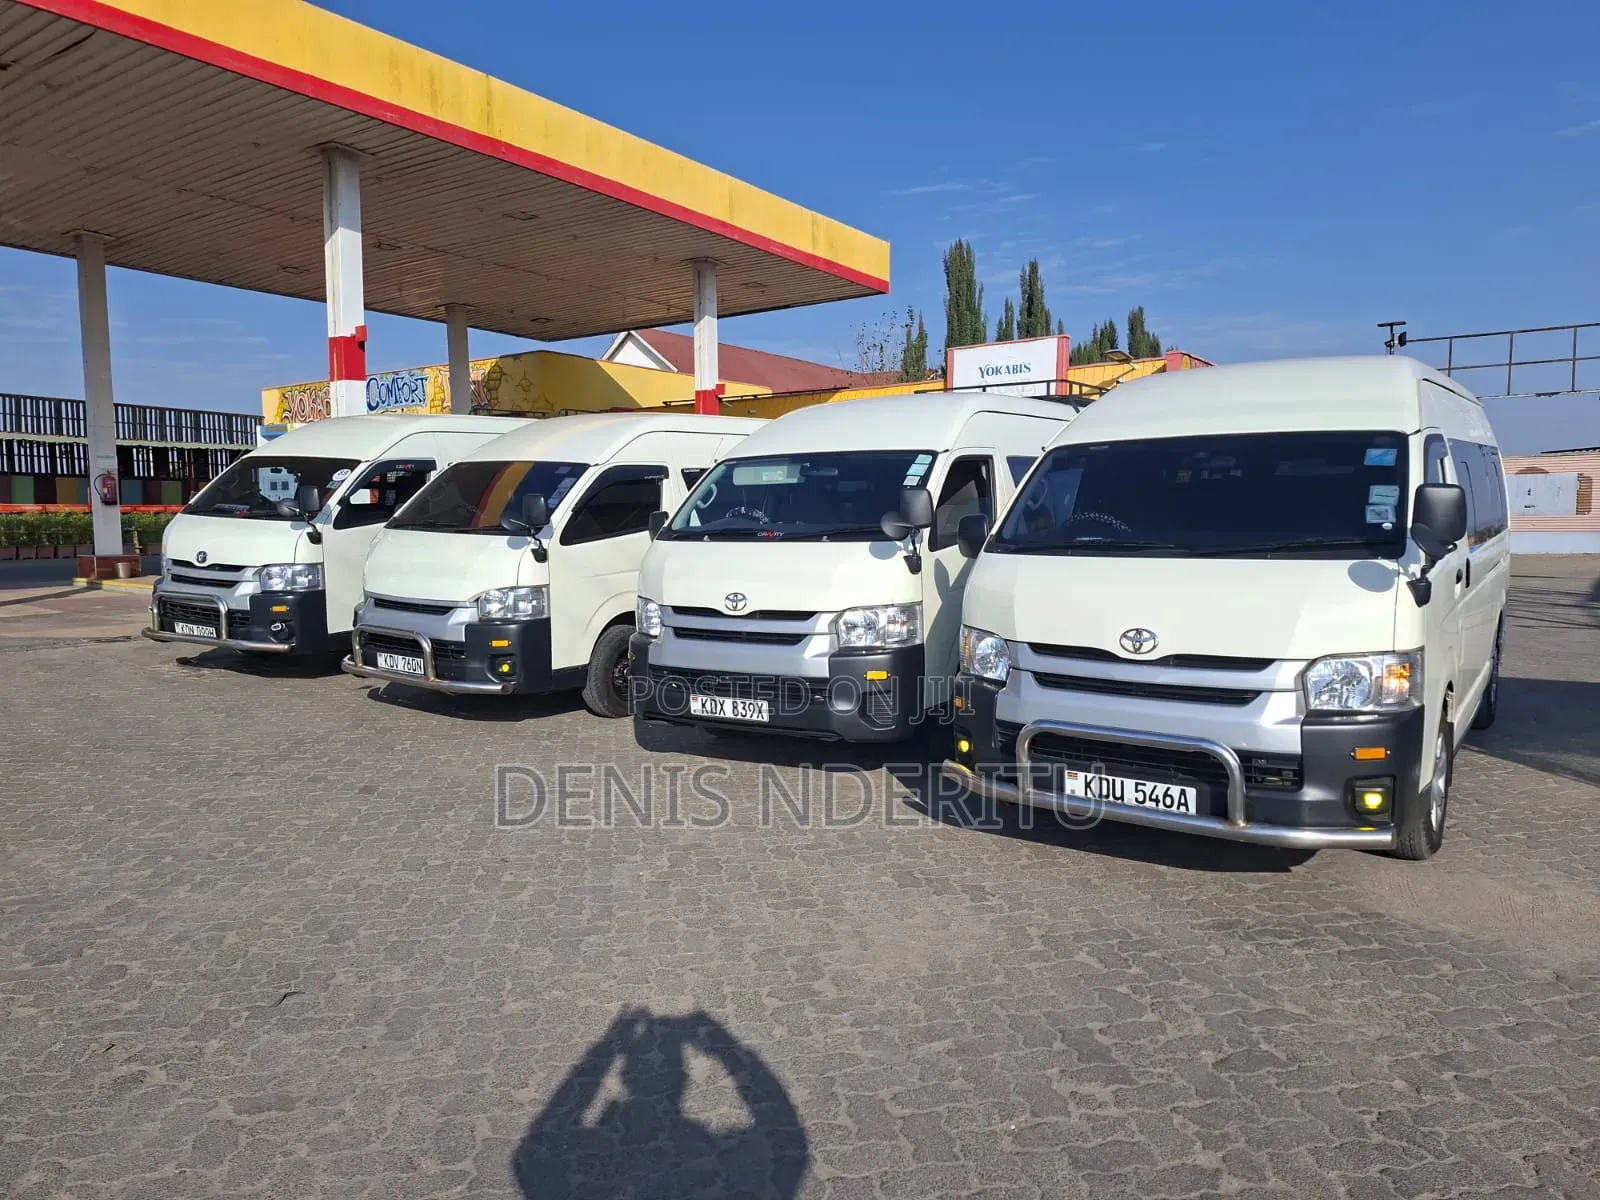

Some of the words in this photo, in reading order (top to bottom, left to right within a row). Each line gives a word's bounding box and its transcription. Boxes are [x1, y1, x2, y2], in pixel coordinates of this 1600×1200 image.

[978, 362, 1032, 379] YOKABIS
[366, 374, 429, 411] COMFORT
[402, 657, 423, 673] 760N
[701, 698, 727, 717] KDX
[731, 701, 765, 720] 839X
[1084, 774, 1126, 803] KDU
[1134, 781, 1190, 813] 546A
